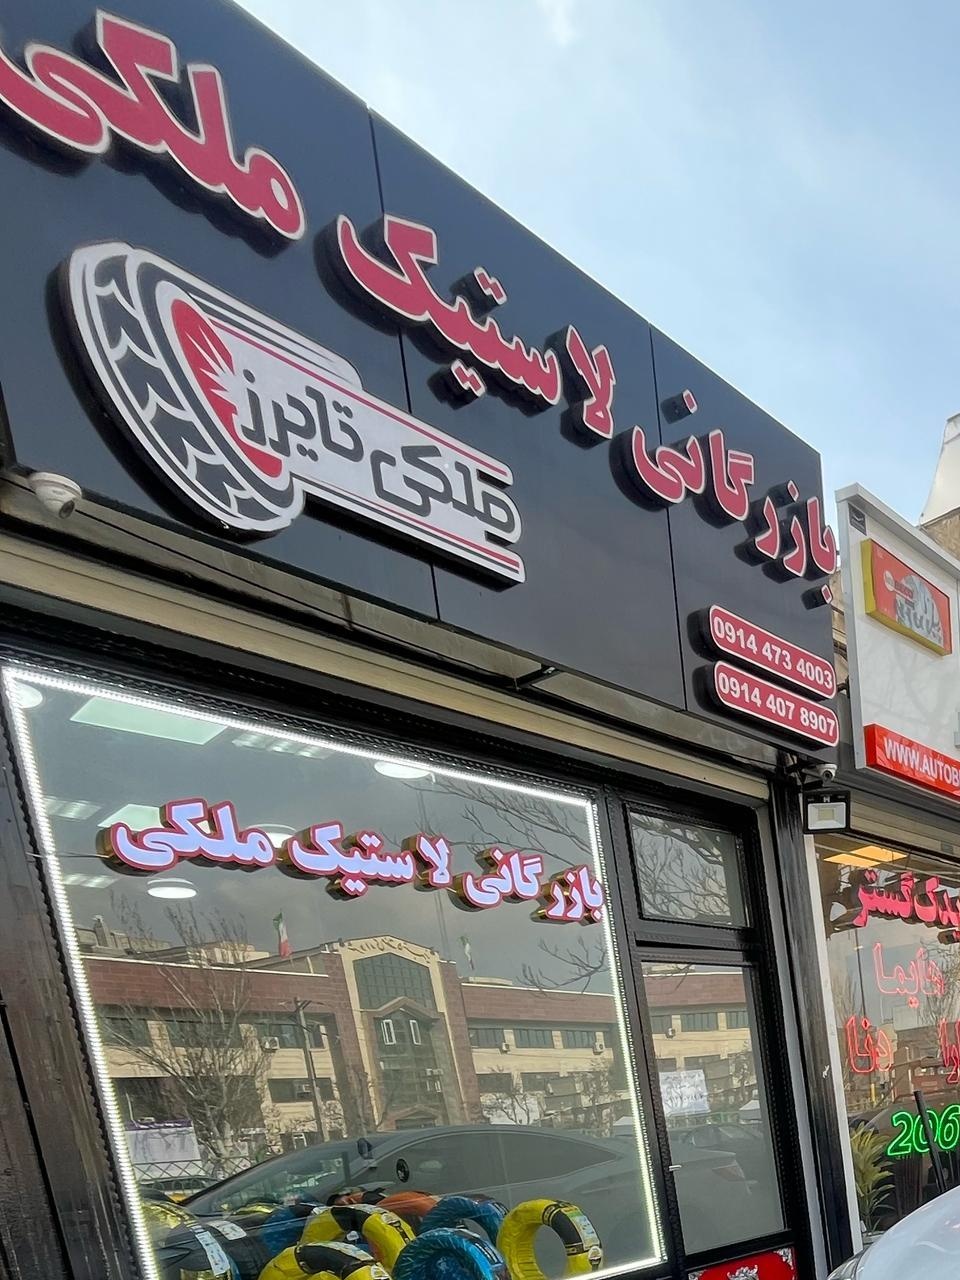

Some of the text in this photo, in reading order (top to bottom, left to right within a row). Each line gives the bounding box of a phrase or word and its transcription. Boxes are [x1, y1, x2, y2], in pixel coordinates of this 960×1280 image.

[0, 7, 305, 240] ملکی
[240, 369, 518, 534] ملکی تایرز
[713, 616, 833, 690] 0914 473 4003
[718, 672, 836, 737] 0914 407 8907
[111, 797, 275, 870] ملکی
[853, 869, 915, 927] گستر
[846, 1014, 894, 1073] دنا
